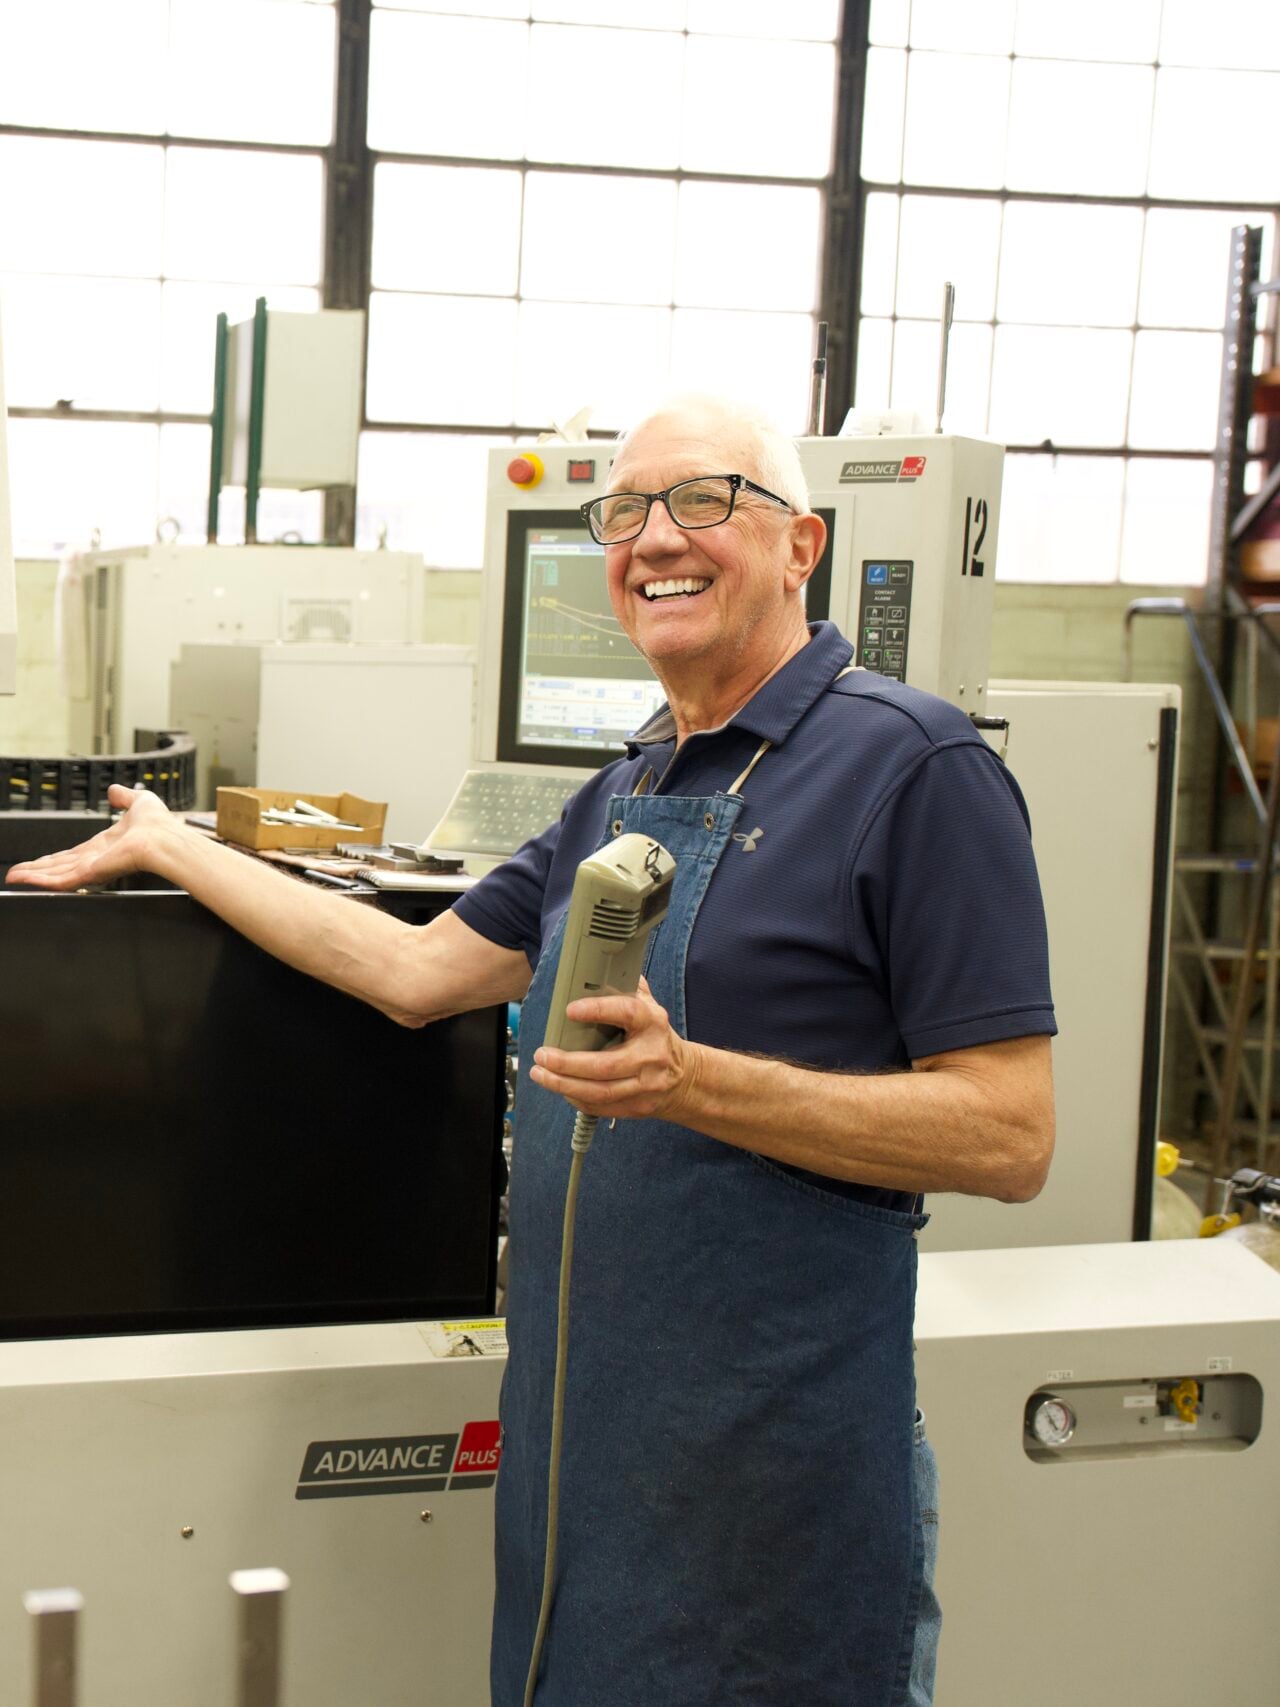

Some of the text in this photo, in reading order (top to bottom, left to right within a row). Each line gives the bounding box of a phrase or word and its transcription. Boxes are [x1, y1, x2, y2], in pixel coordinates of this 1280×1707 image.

[845, 464, 897, 475] ADVANCE
[961, 496, 988, 577] 12
[313, 1445, 498, 1474] ADVANCE PLUS
